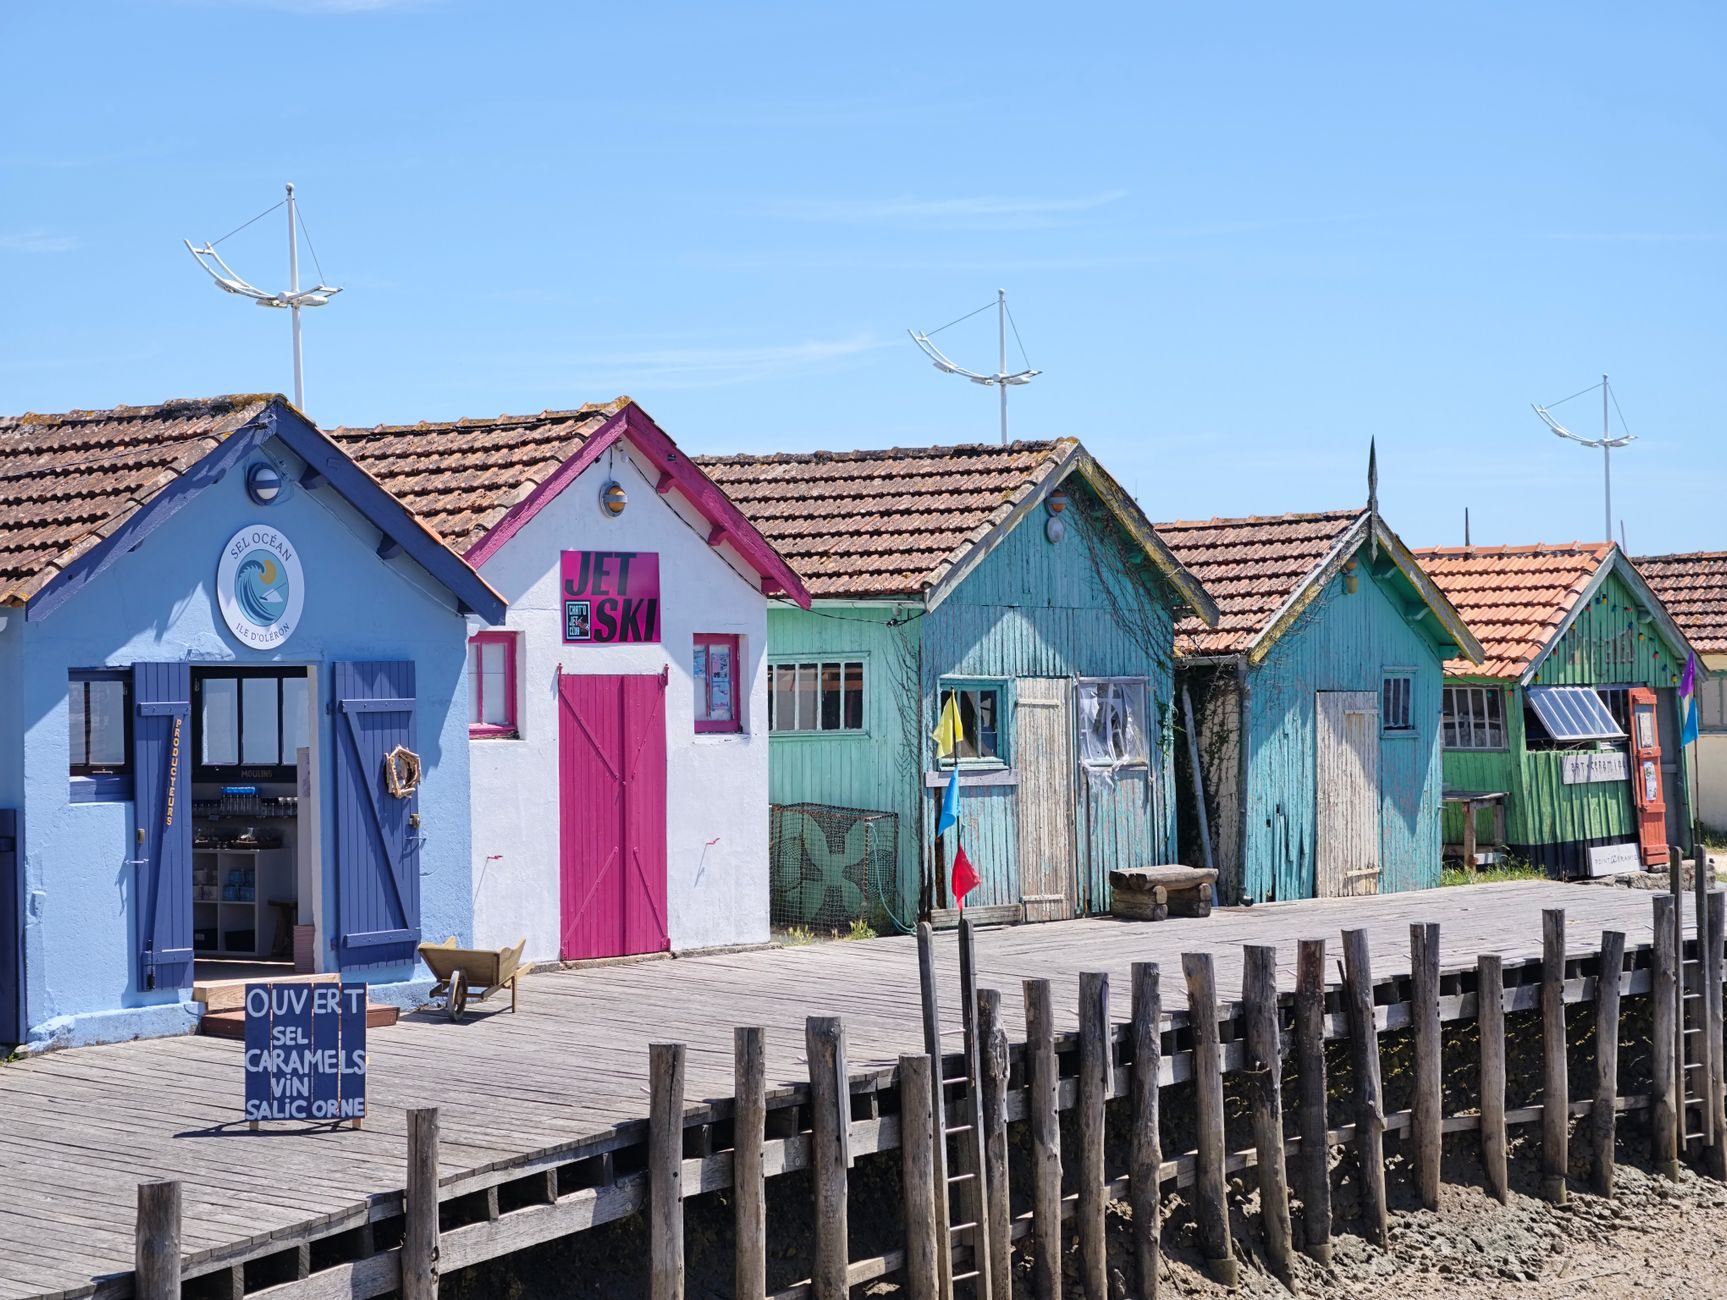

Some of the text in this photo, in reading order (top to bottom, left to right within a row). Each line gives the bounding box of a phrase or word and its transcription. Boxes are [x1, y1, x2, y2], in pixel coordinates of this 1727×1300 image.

[231, 532, 292, 562] SEL OCÉAN
[564, 551, 637, 596] JET
[235, 622, 290, 643] ILE D'OLÉRON
[594, 598, 657, 642] SKI
[166, 719, 182, 825] PRODUCTEURS
[241, 769, 273, 778] MOULINS
[246, 988, 364, 1018] OUVERT
[272, 1026, 309, 1046] SEL
[245, 1049, 366, 1075] CARAMELS
